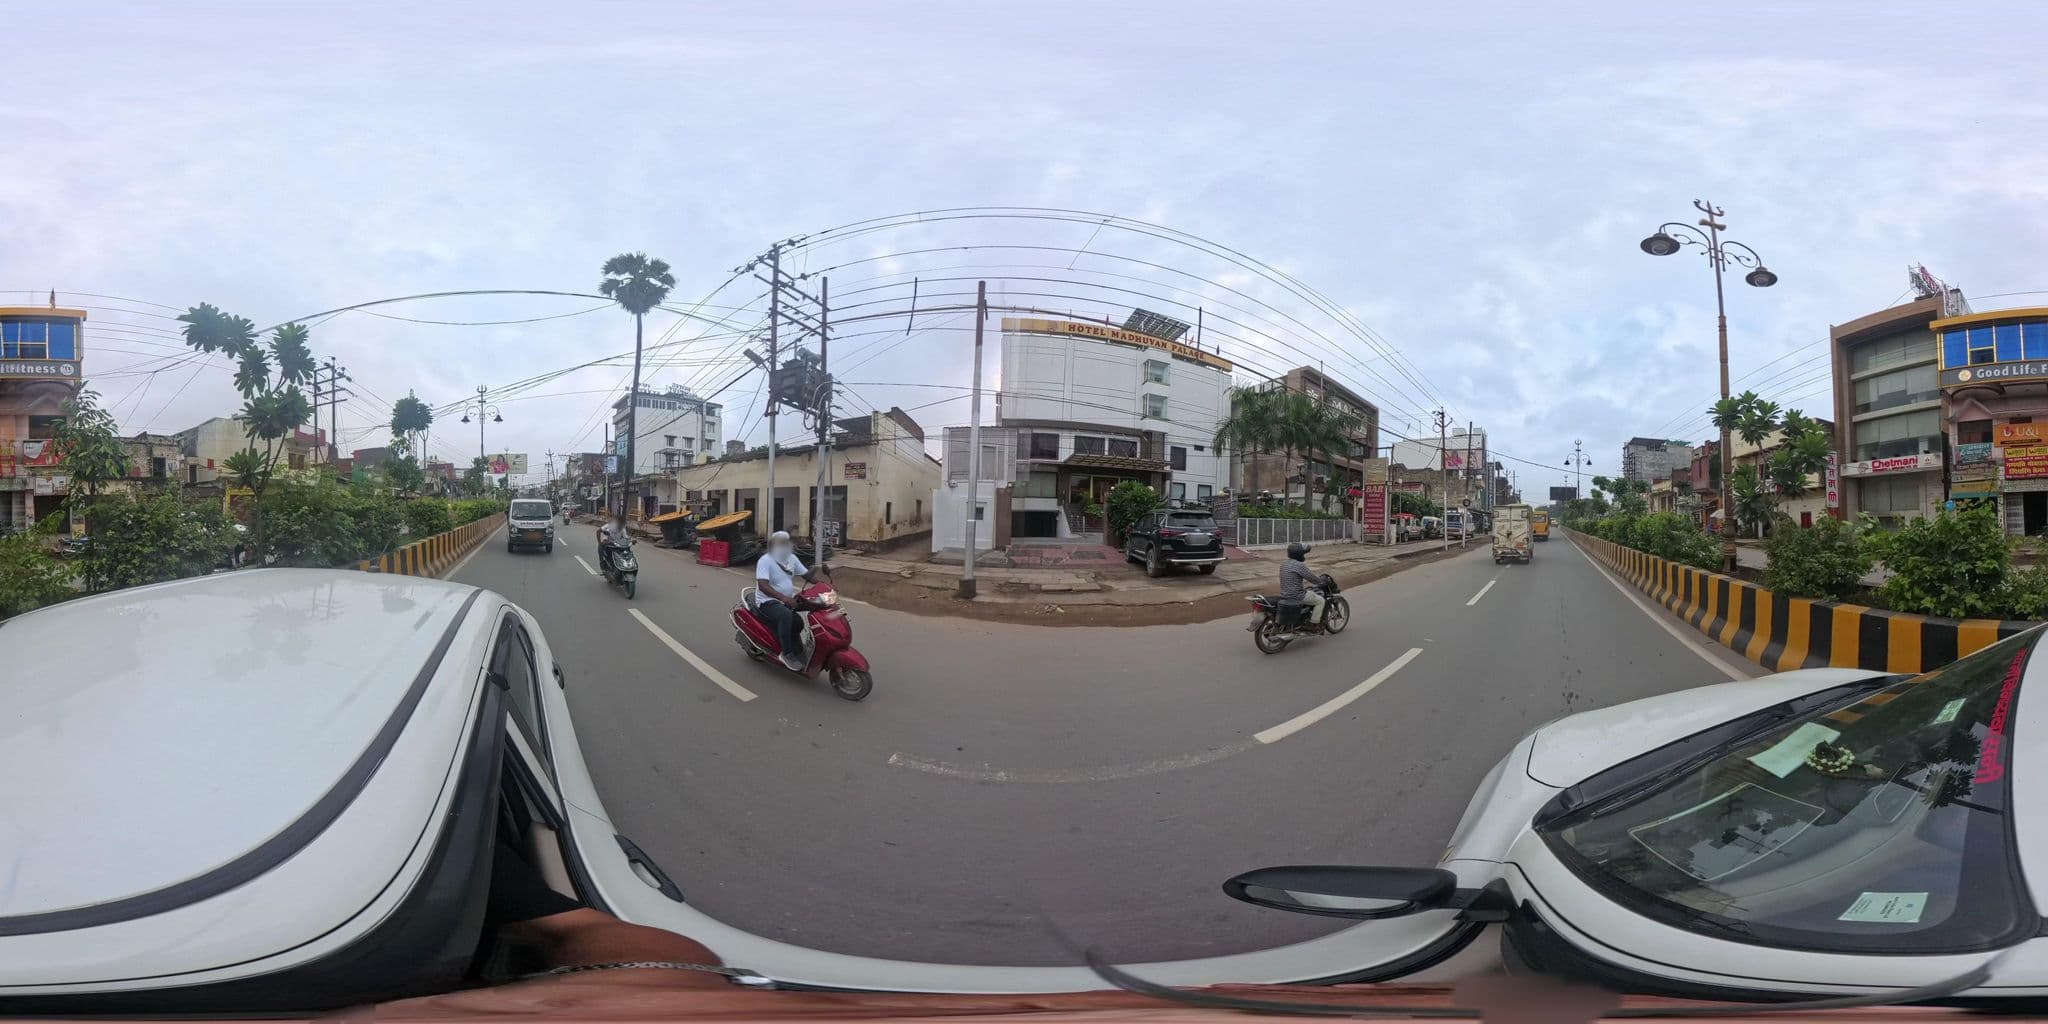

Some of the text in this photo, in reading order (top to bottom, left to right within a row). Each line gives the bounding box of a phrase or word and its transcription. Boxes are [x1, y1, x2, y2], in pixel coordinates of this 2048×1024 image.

[1068, 324, 1205, 359] HOTEL MADHUVAN PALACE
[1976, 366, 2009, 379] Good
[2012, 364, 2037, 375] Life
[1872, 456, 1919, 469] Chetmani
[1366, 485, 1384, 493] BAR
